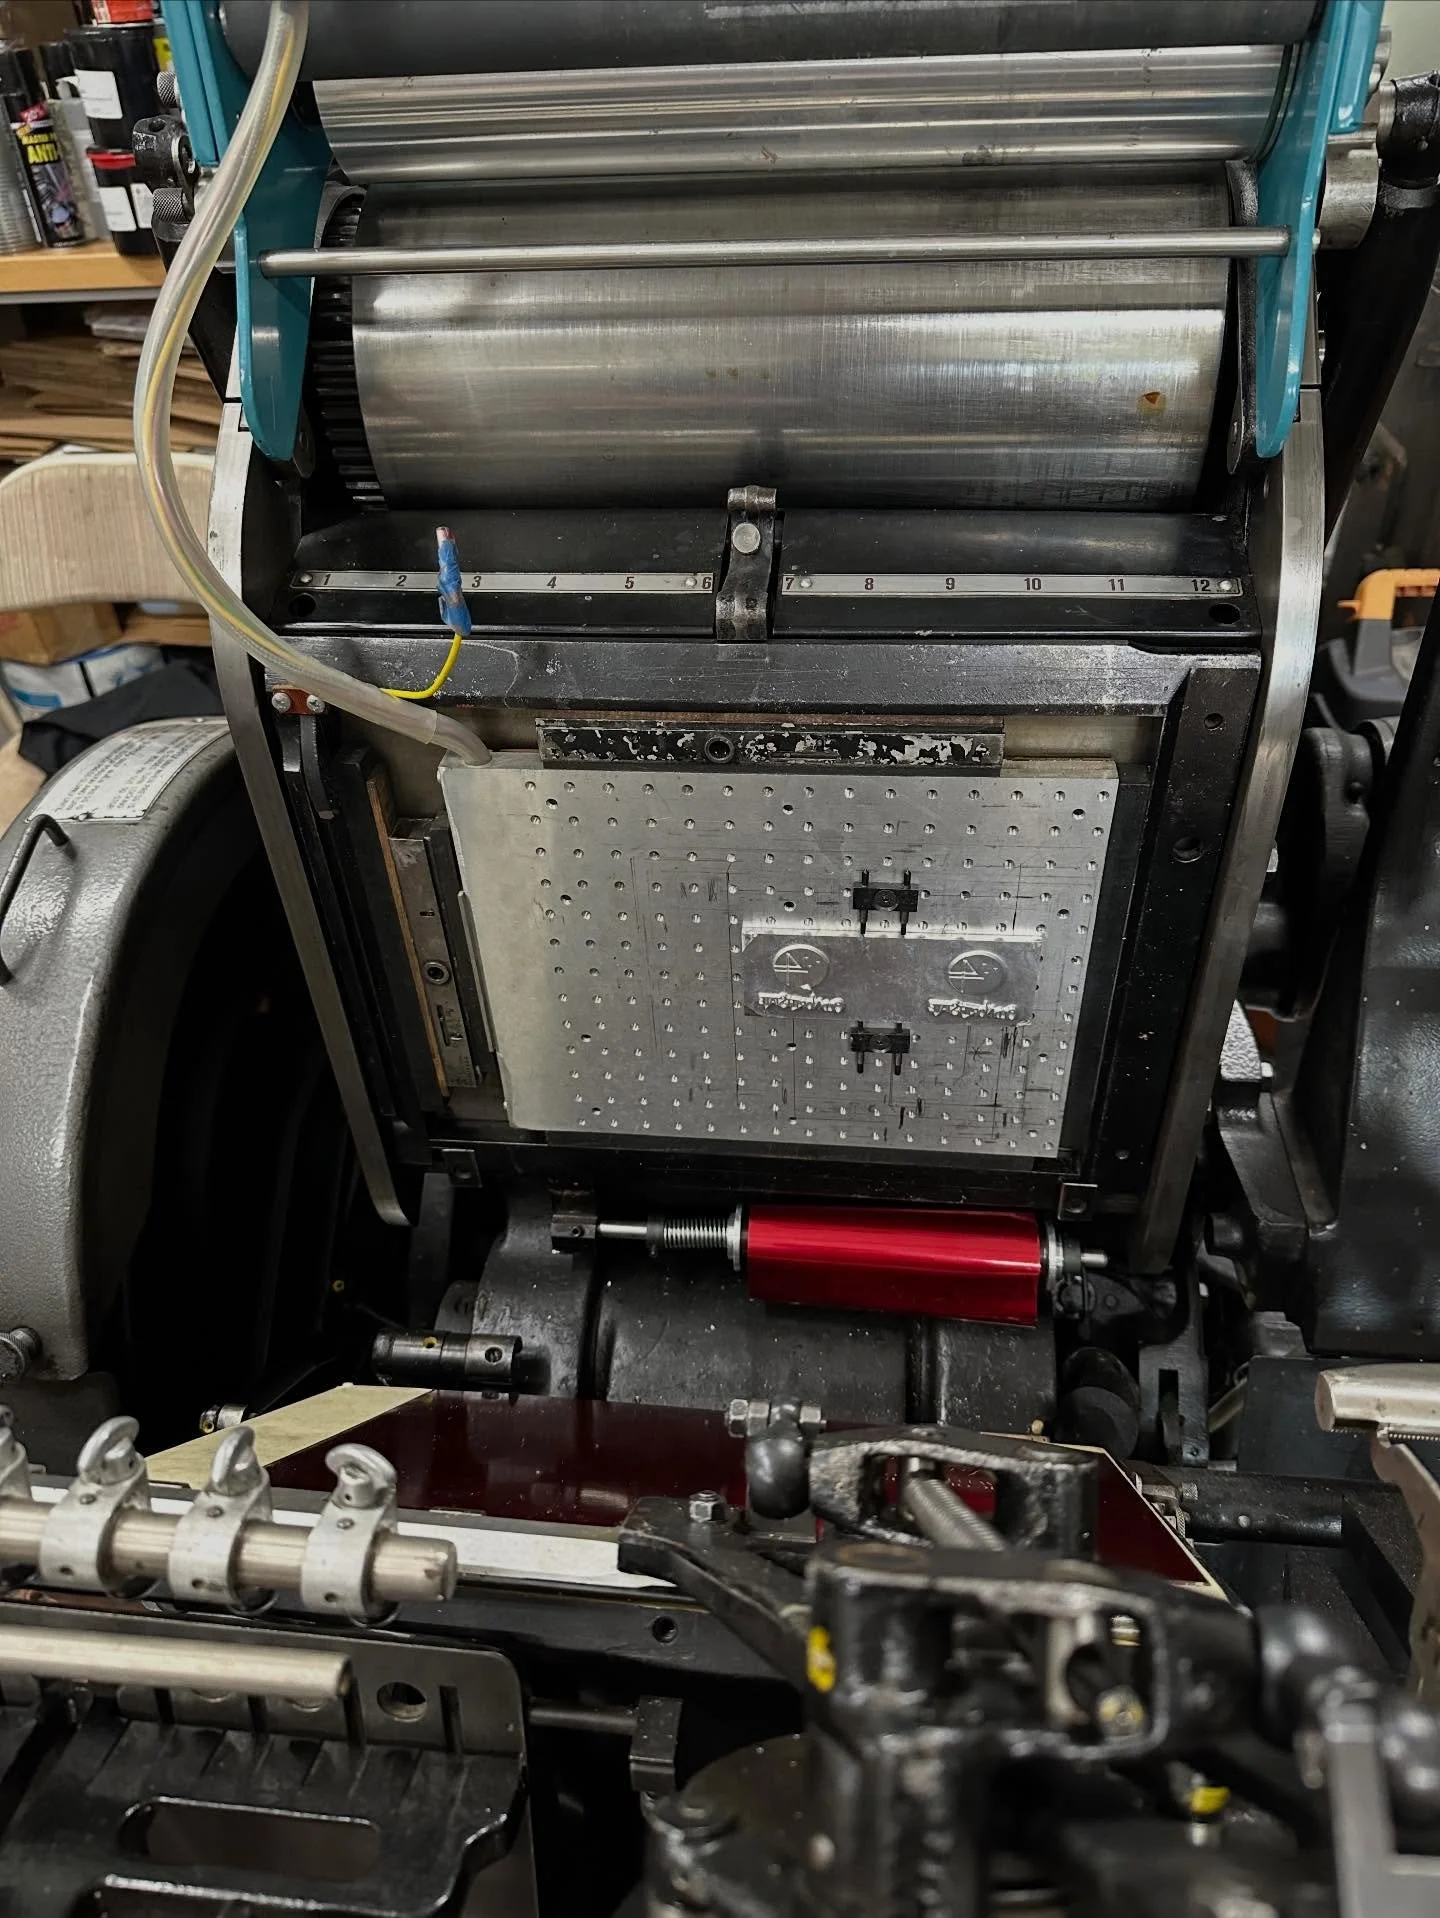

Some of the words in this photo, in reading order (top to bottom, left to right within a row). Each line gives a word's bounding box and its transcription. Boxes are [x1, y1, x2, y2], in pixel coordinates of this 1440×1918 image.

[324, 573, 331, 586] 1
[396, 574, 407, 587] 2
[471, 575, 482, 588] 3
[547, 575, 557, 589] 4
[624, 576, 635, 589] 5
[702, 576, 712, 589] 6
[785, 577, 795, 590] 7
[865, 577, 874, 590] 8
[946, 577, 955, 590] 9
[1024, 577, 1042, 590] 10
[1108, 578, 1125, 591] 11
[1191, 578, 1212, 592] 12
